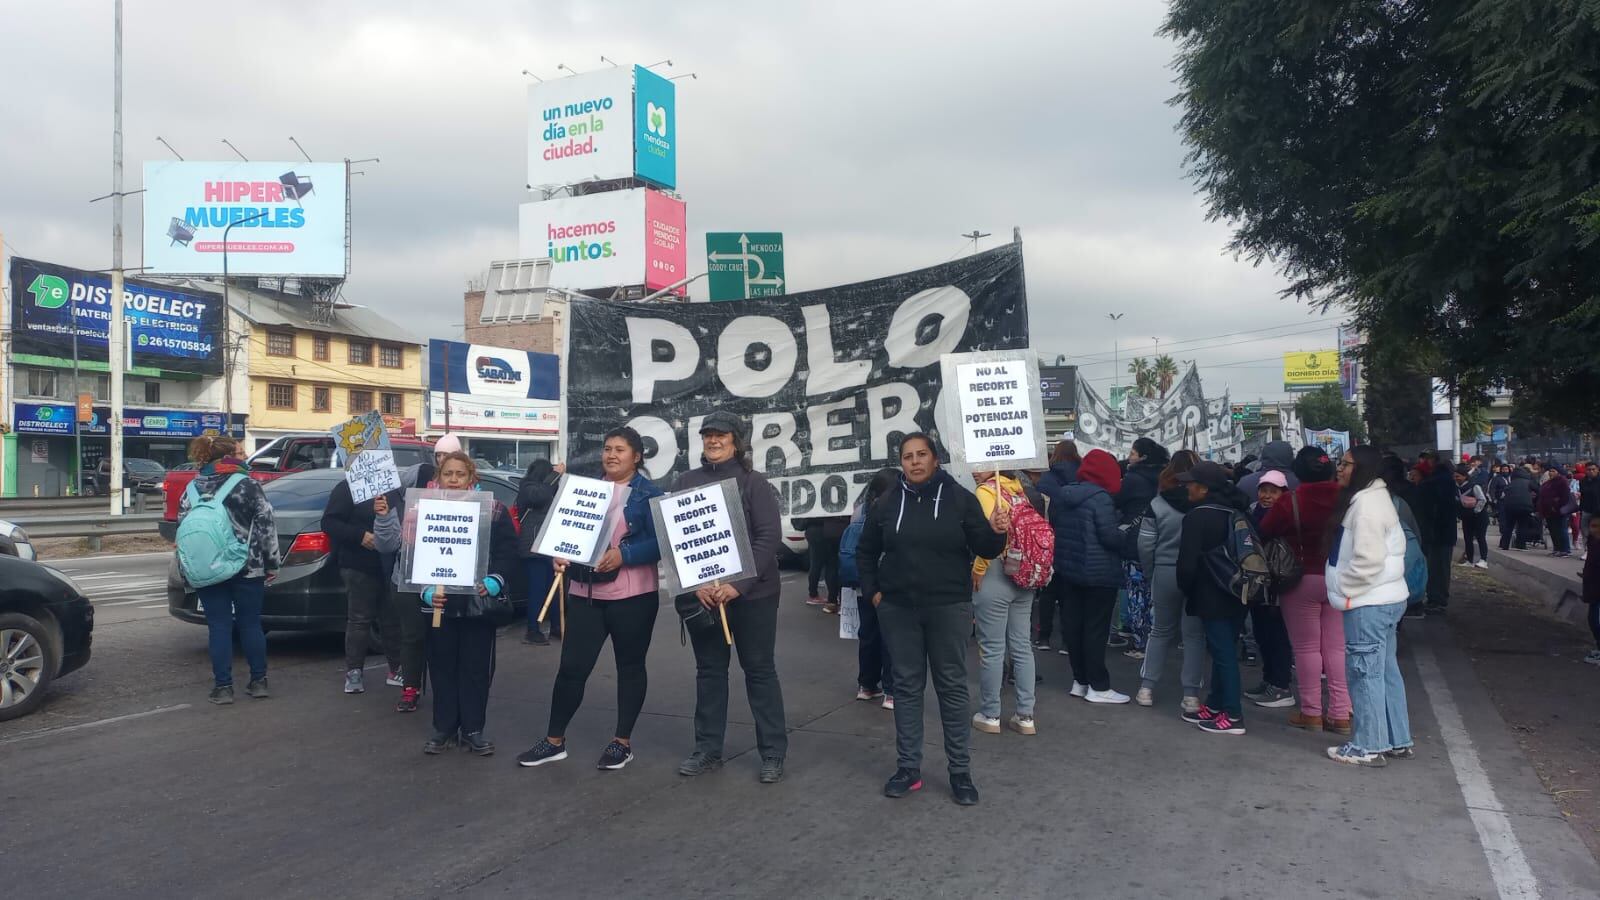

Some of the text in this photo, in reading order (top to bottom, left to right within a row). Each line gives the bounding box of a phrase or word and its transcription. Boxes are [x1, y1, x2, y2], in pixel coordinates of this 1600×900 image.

[543, 97, 612, 121] un nuevo
[543, 114, 604, 141] día en la
[543, 136, 598, 161] ciudad.
[204, 181, 285, 203] HIPER
[185, 207, 305, 228] MUEBLES
[548, 220, 616, 240] hacemos
[548, 241, 617, 263] juntos.
[750, 244, 782, 252] MENDOZA
[728, 263, 744, 271] CRUZ
[750, 288, 783, 296] LAS HERAS
[71, 307, 198, 333] MATERIES ELECTRICOS
[149, 336, 212, 352] 2615705834
[625, 284, 971, 404] POLO
[975, 366, 1008, 377] NO AL
[969, 380, 1018, 392] RECORTE
[976, 396, 1014, 407] DEL EX
[965, 410, 1028, 423] POTENCIAR
[18, 420, 69, 429] DISTROELECT
[973, 426, 1023, 438] TRABAJO
[358, 452, 370, 463] NO
[985, 449, 1015, 457] OBRERO
[572, 488, 607, 500] ABAJO EL
[677, 493, 707, 507] NO AL
[576, 499, 597, 509] PLAN
[424, 513, 473, 523] ALIMENTOS
[673, 504, 718, 524] RECORTE
[428, 525, 451, 533] PARA
[572, 521, 595, 531] MILEI
[682, 519, 716, 535] DEL EX
[422, 536, 472, 545] COMEDORES
[560, 541, 579, 549] POLO
[674, 529, 732, 552] POTENCIAR
[440, 547, 453, 556] YA
[554, 546, 581, 556] OBRERO
[683, 545, 730, 564] TRABAJO
[698, 567, 726, 580] OBRERO
[701, 563, 719, 573] POLO
